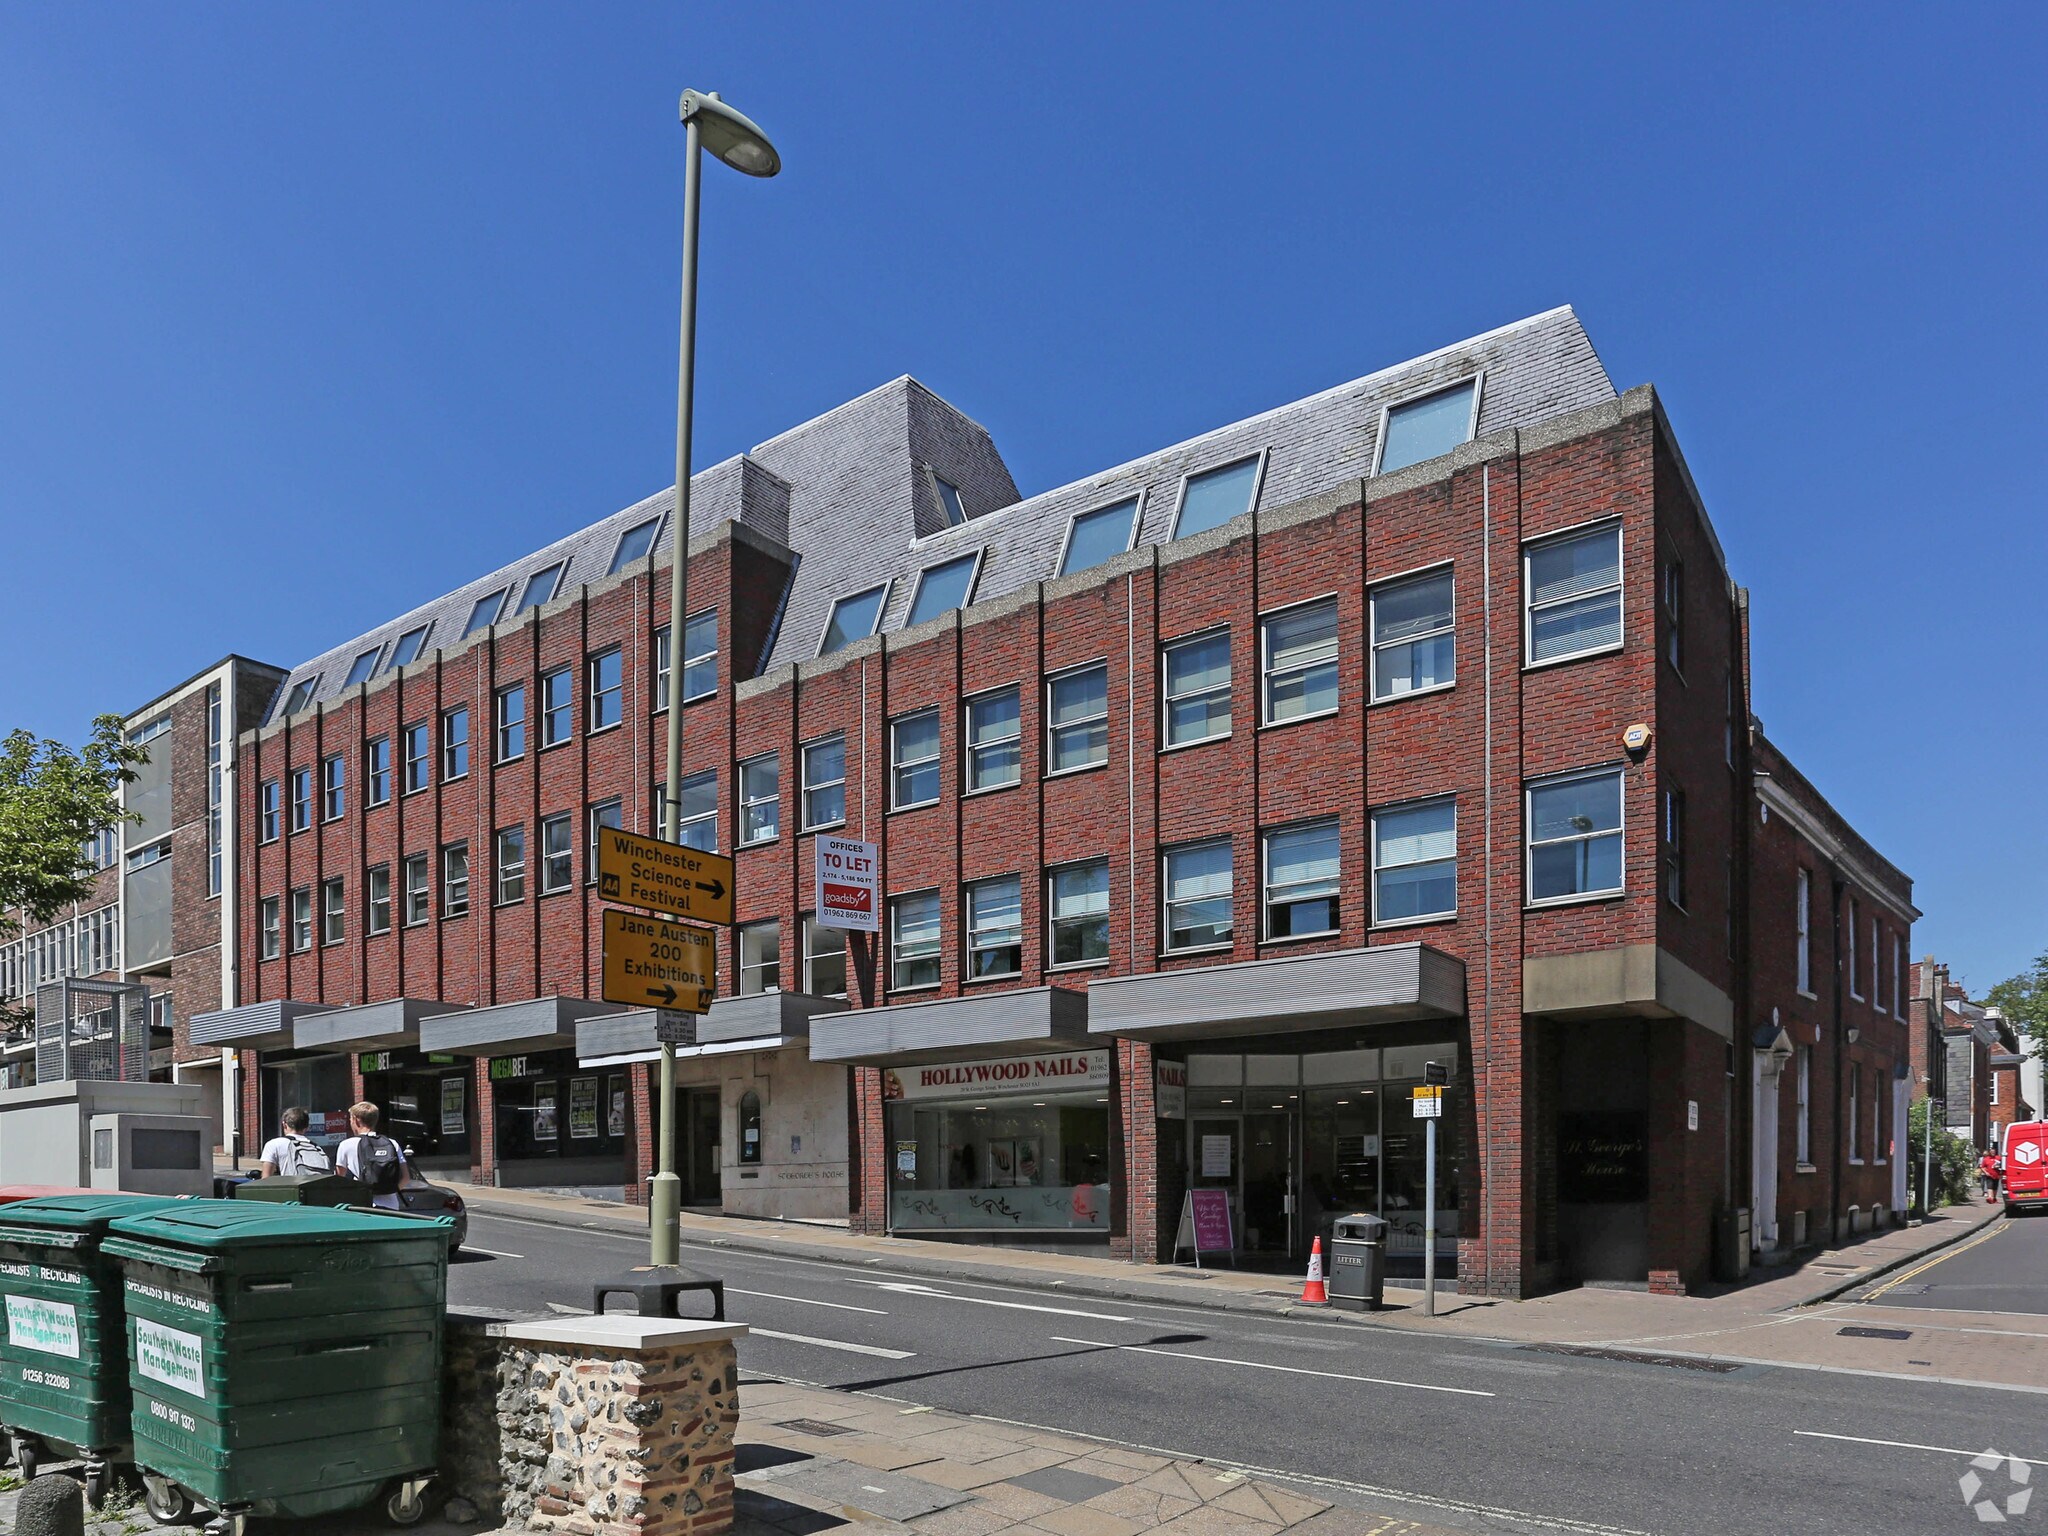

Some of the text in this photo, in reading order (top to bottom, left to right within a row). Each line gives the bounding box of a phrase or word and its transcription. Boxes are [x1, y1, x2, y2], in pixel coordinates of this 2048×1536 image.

[1629, 731, 1641, 740] ADT
[614, 836, 702, 872] Winchester
[830, 841, 863, 853] OFFICES
[823, 853, 871, 872] TO LET
[604, 878, 619, 893] AA
[631, 862, 691, 889] Science
[631, 882, 690, 910] Festival
[825, 893, 860, 907] goadsby
[823, 908, 844, 918] 01962
[845, 911, 858, 919] 869
[620, 916, 709, 947] Jane Austen
[650, 943, 681, 961] 200
[625, 959, 706, 985] Exhibitions
[361, 1052, 390, 1073] MEGABET
[491, 1057, 527, 1079] MEGABET
[921, 1057, 1088, 1086] HOLLYWOOD NAILS
[1091, 1064, 1107, 1072] 01962
[1158, 1066, 1186, 1087] NAILS
[1337, 1256, 1362, 1264] LITTER
[40, 1267, 81, 1284] RECYCLING
[127, 1278, 210, 1313] SPECIALISTS IN RECYCLING
[8, 1302, 75, 1328] Southern Waste
[15, 1321, 72, 1345] Management
[138, 1326, 200, 1363] Southern Waste
[23, 1368, 43, 1384] 01256
[143, 1349, 197, 1383] Management
[151, 1400, 195, 1432] 0800 917 1373
